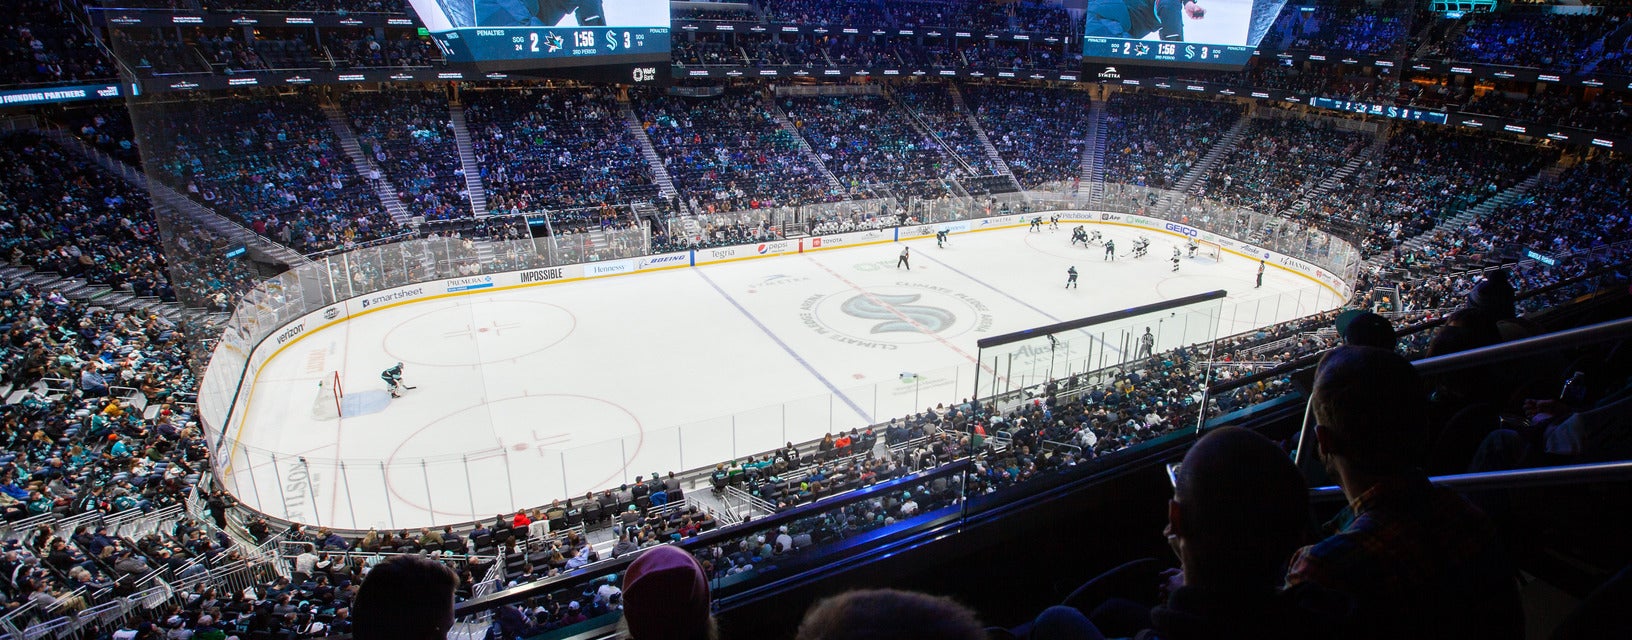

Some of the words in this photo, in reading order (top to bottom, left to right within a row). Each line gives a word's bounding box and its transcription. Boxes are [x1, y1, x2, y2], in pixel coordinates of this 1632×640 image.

[530, 32, 539, 53] 2
[573, 31, 595, 48] 1:56
[623, 31, 631, 49] 3
[1123, 42, 1131, 55] 2
[1158, 43, 1176, 55] 1:56
[1200, 46, 1209, 60] 3
[3, 92, 45, 104] FOUNDING
[43, 89, 87, 102] PARTNERS
[1165, 222, 1198, 238] GEICO
[768, 241, 788, 251] pepsi
[650, 254, 686, 264] BOEING
[711, 248, 735, 259] Tegria
[519, 267, 563, 283] IMPOSSIBLE
[593, 264, 626, 274] Hennessy
[446, 277, 482, 287] PREMERA
[371, 287, 424, 305] smartsheet
[276, 323, 304, 344] verizon
